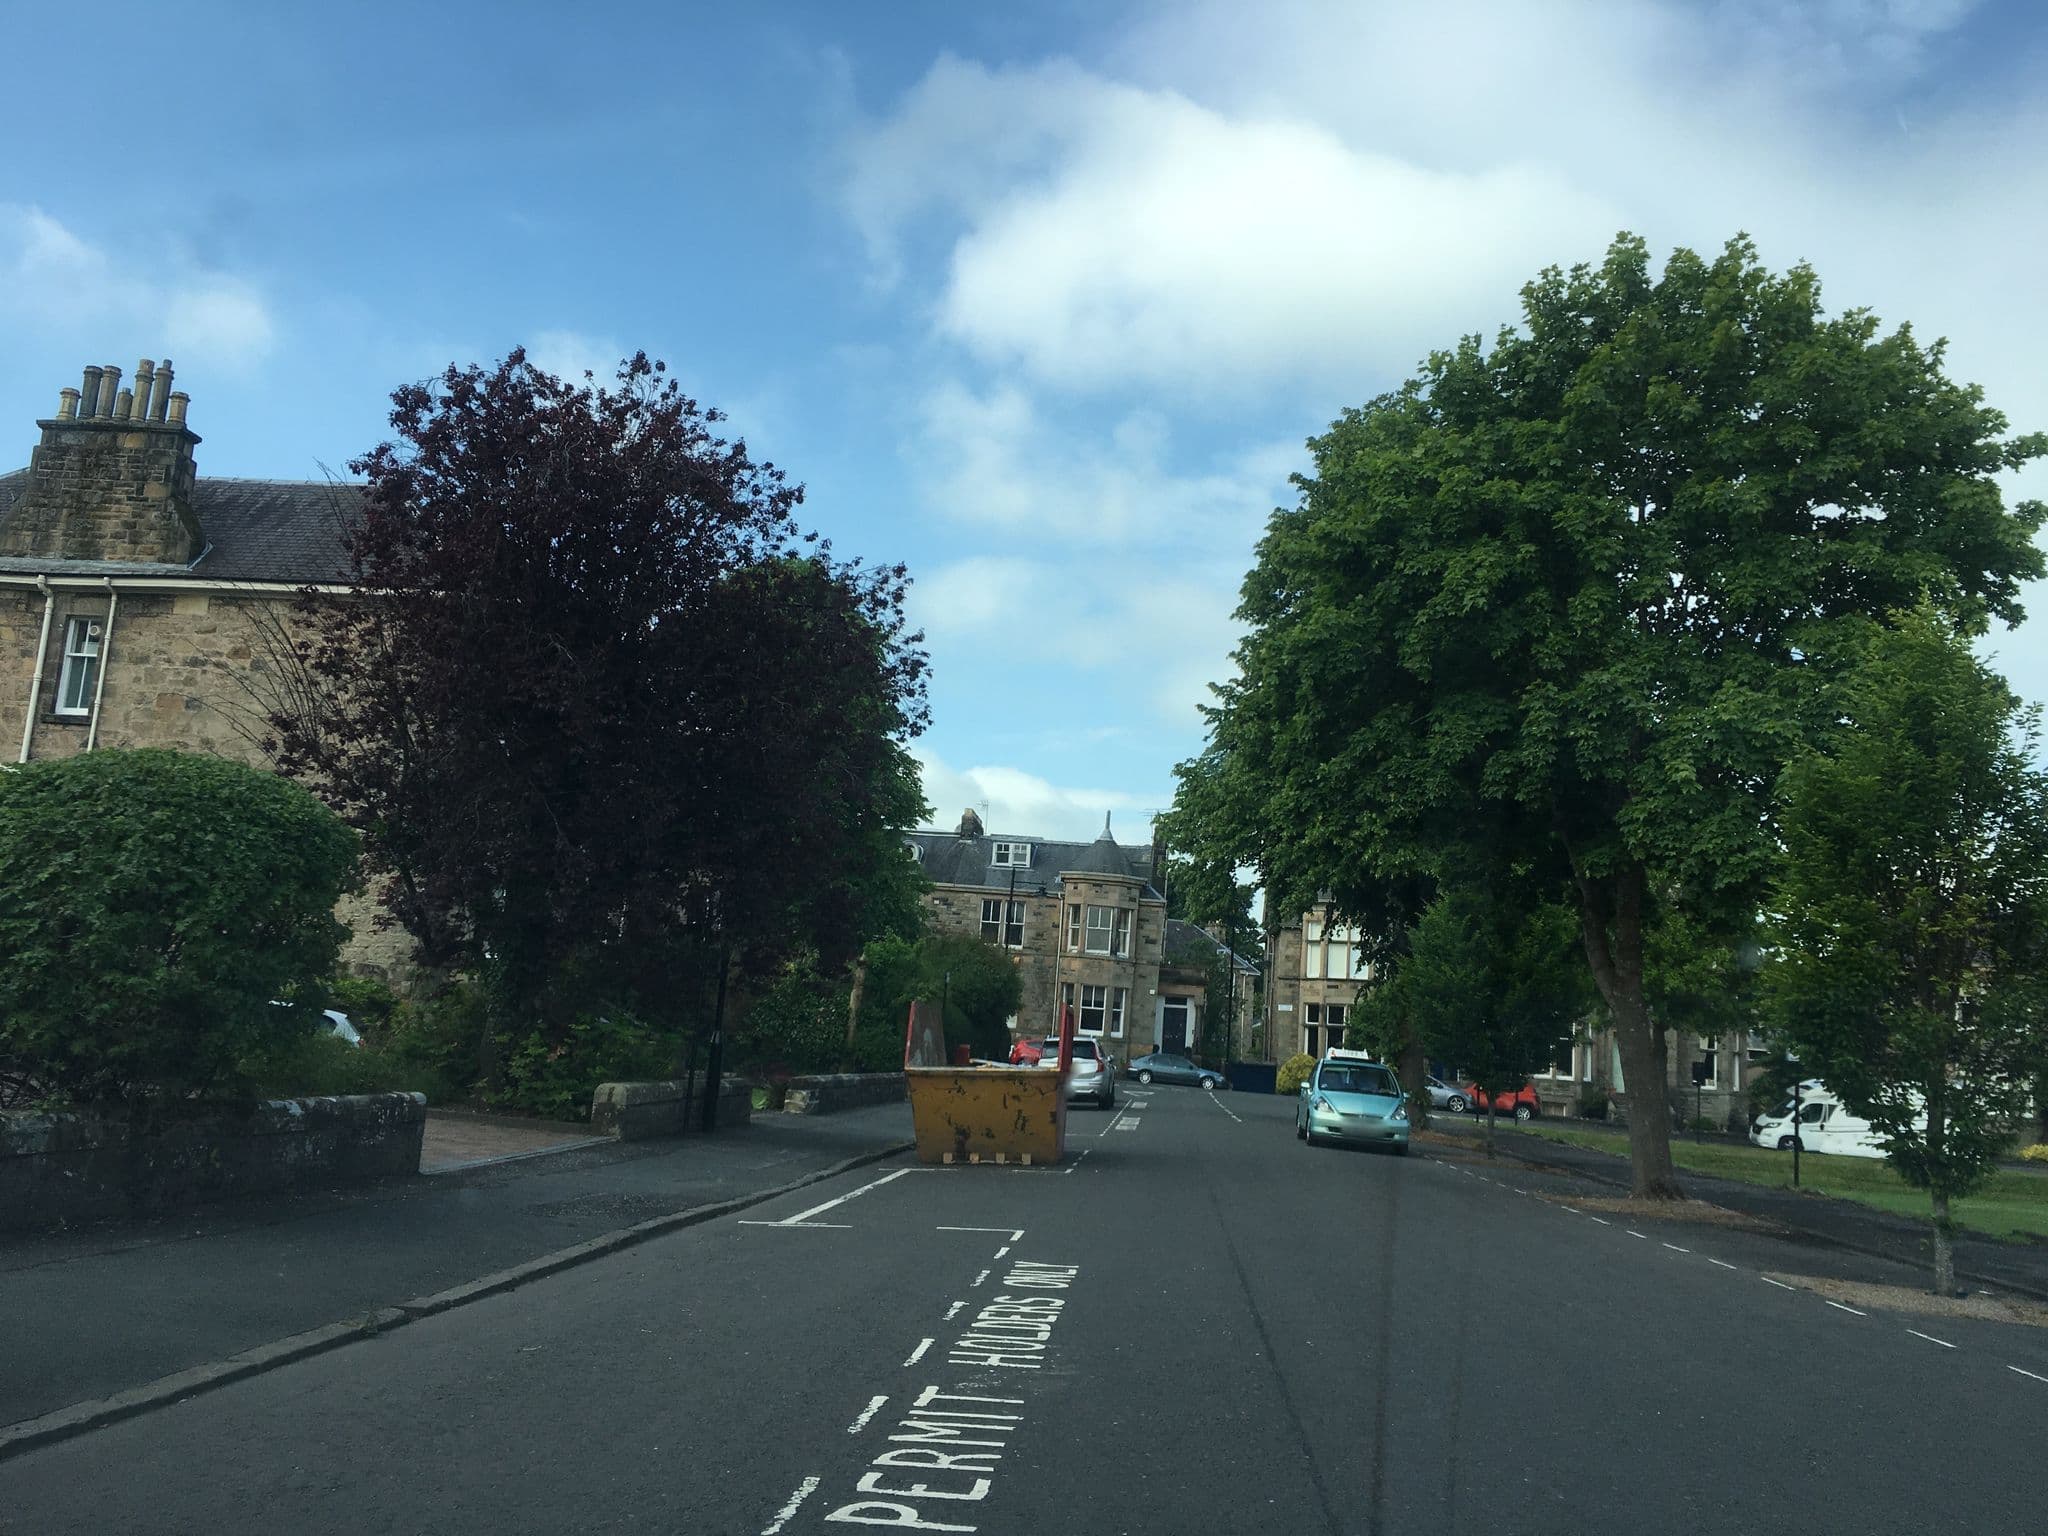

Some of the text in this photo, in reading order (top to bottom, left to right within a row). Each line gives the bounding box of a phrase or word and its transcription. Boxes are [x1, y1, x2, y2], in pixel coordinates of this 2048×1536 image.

[825, 1260, 1080, 1532] PERMIT HOLDERS ONLY
